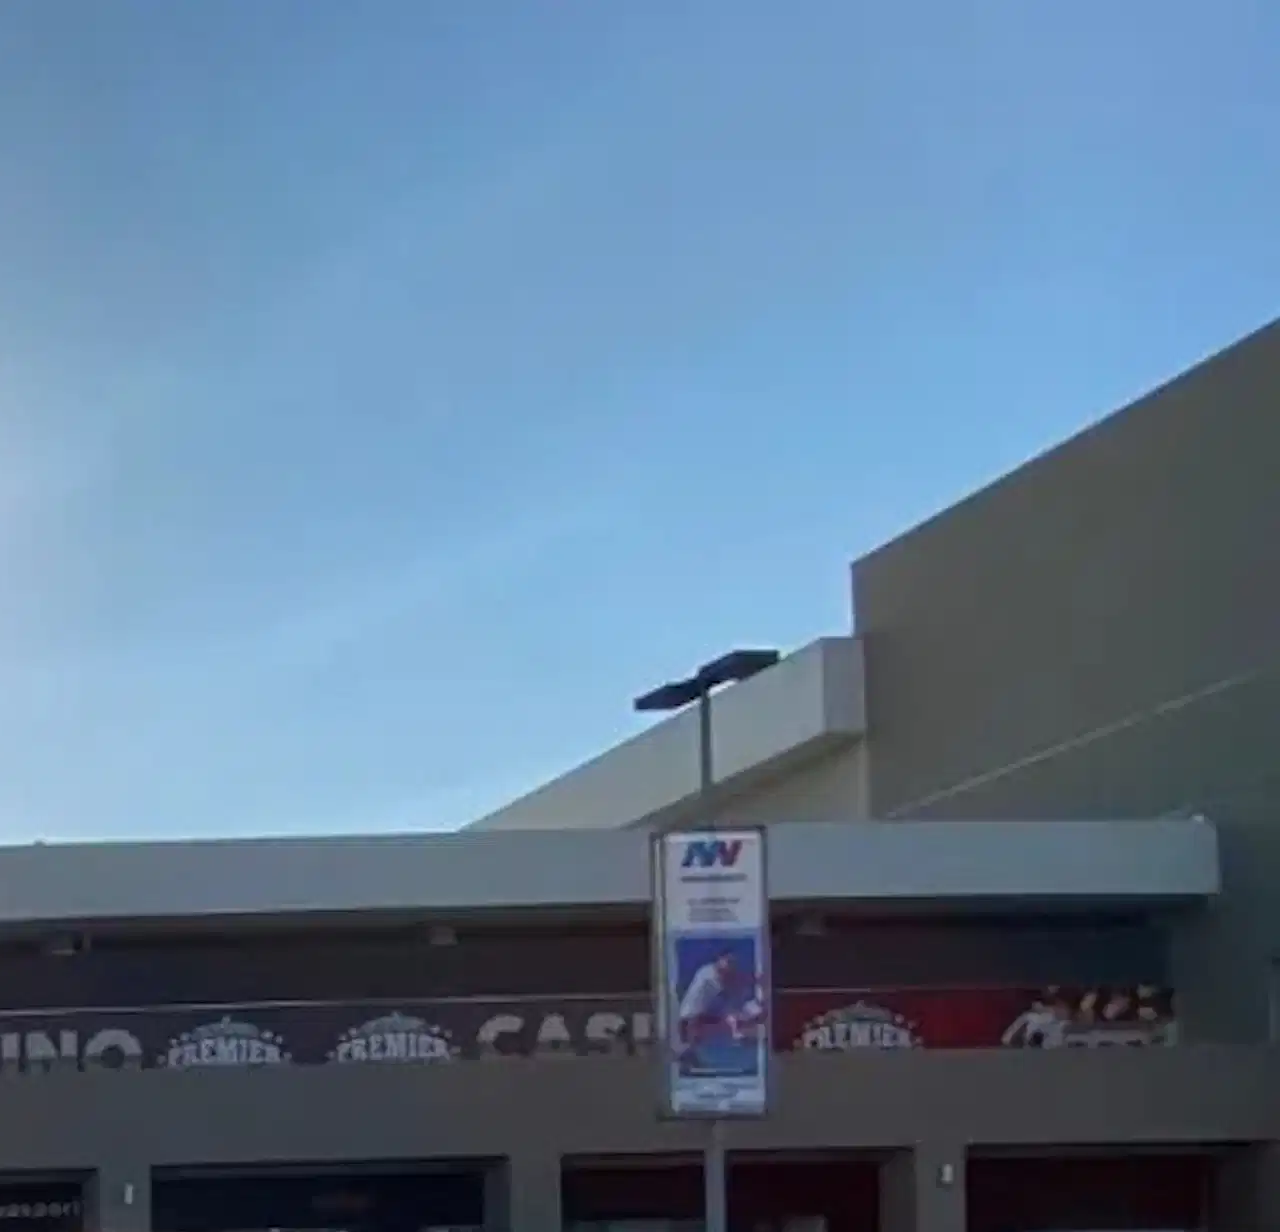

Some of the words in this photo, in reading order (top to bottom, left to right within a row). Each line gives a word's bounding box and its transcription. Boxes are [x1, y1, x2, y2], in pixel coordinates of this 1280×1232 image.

[167, 1035, 280, 1067] PREMIER
[338, 1032, 450, 1062] PREMIER
[476, 1013, 653, 1058] CASI
